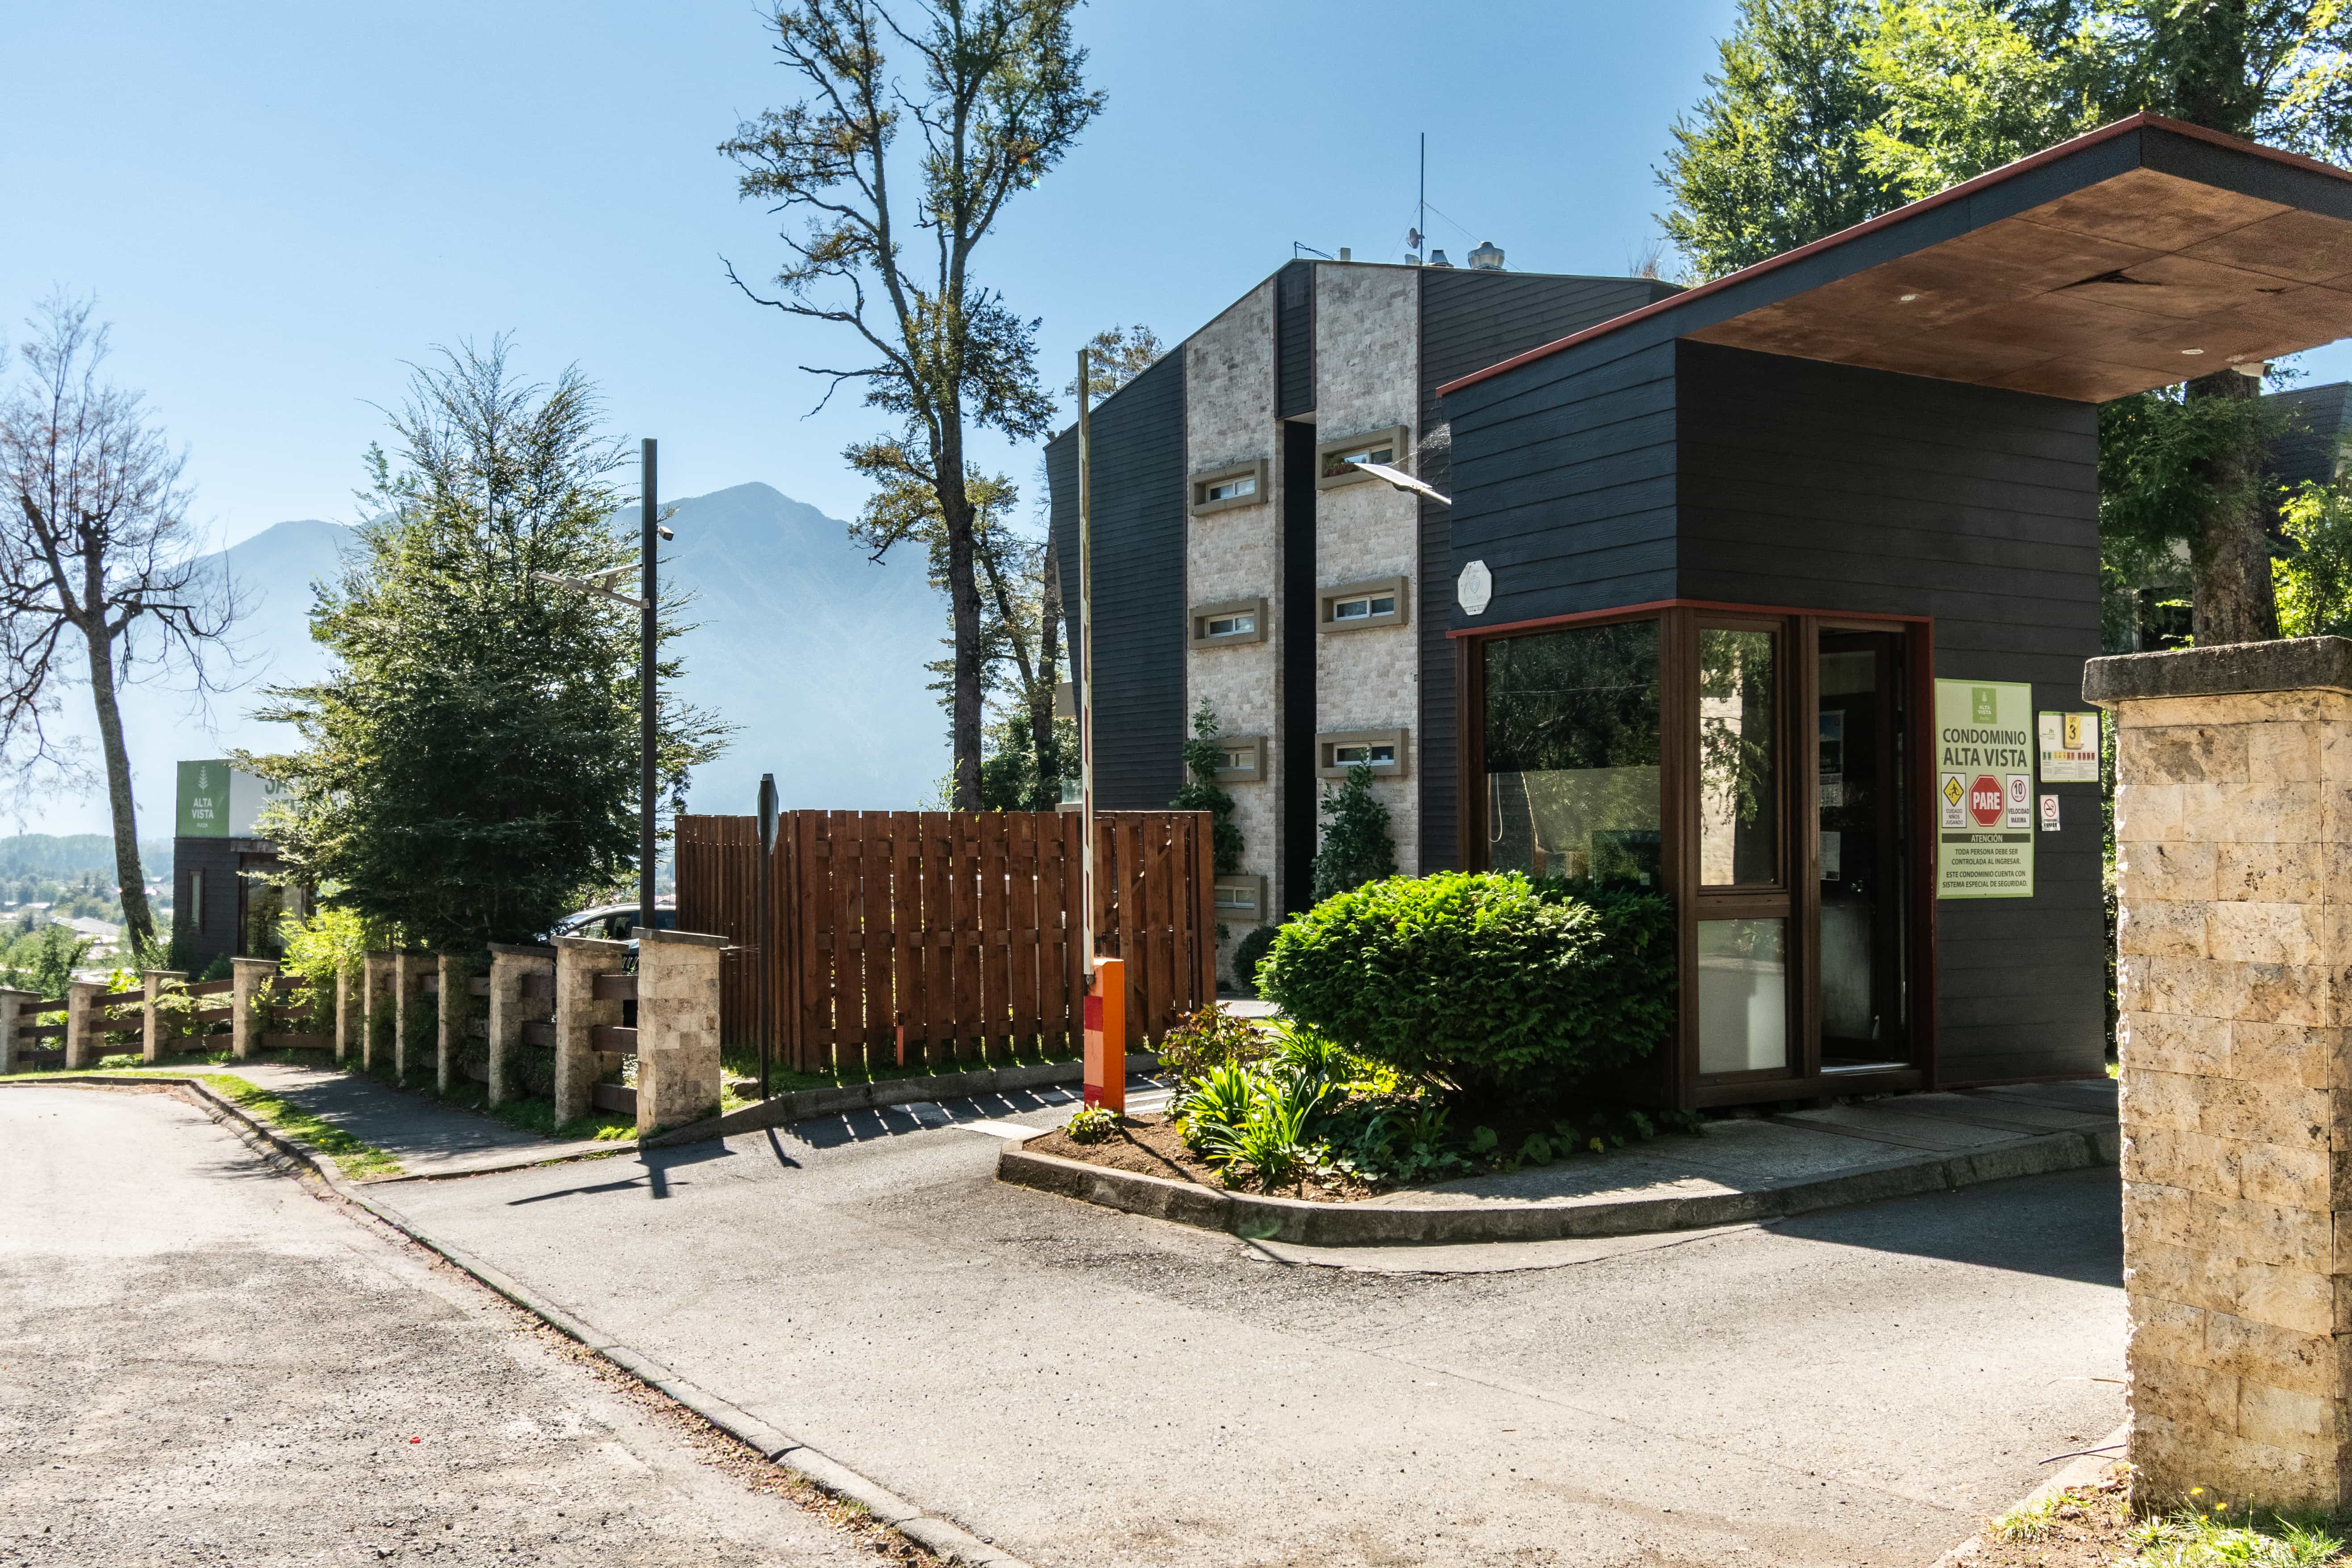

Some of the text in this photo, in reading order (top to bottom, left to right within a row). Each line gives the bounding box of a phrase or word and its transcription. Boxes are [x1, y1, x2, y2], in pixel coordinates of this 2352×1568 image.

[1943, 728, 2027, 745] CONDOMINIO
[2069, 725, 2076, 740] 3
[1943, 747, 2027, 767] ALTA VISTA
[2014, 783, 2023, 795] 10
[193, 798, 212, 808] ALTA
[1973, 792, 2000, 810] PARE
[191, 809, 214, 819] VISTA
[1971, 833, 2003, 842] ATENCIÓN
